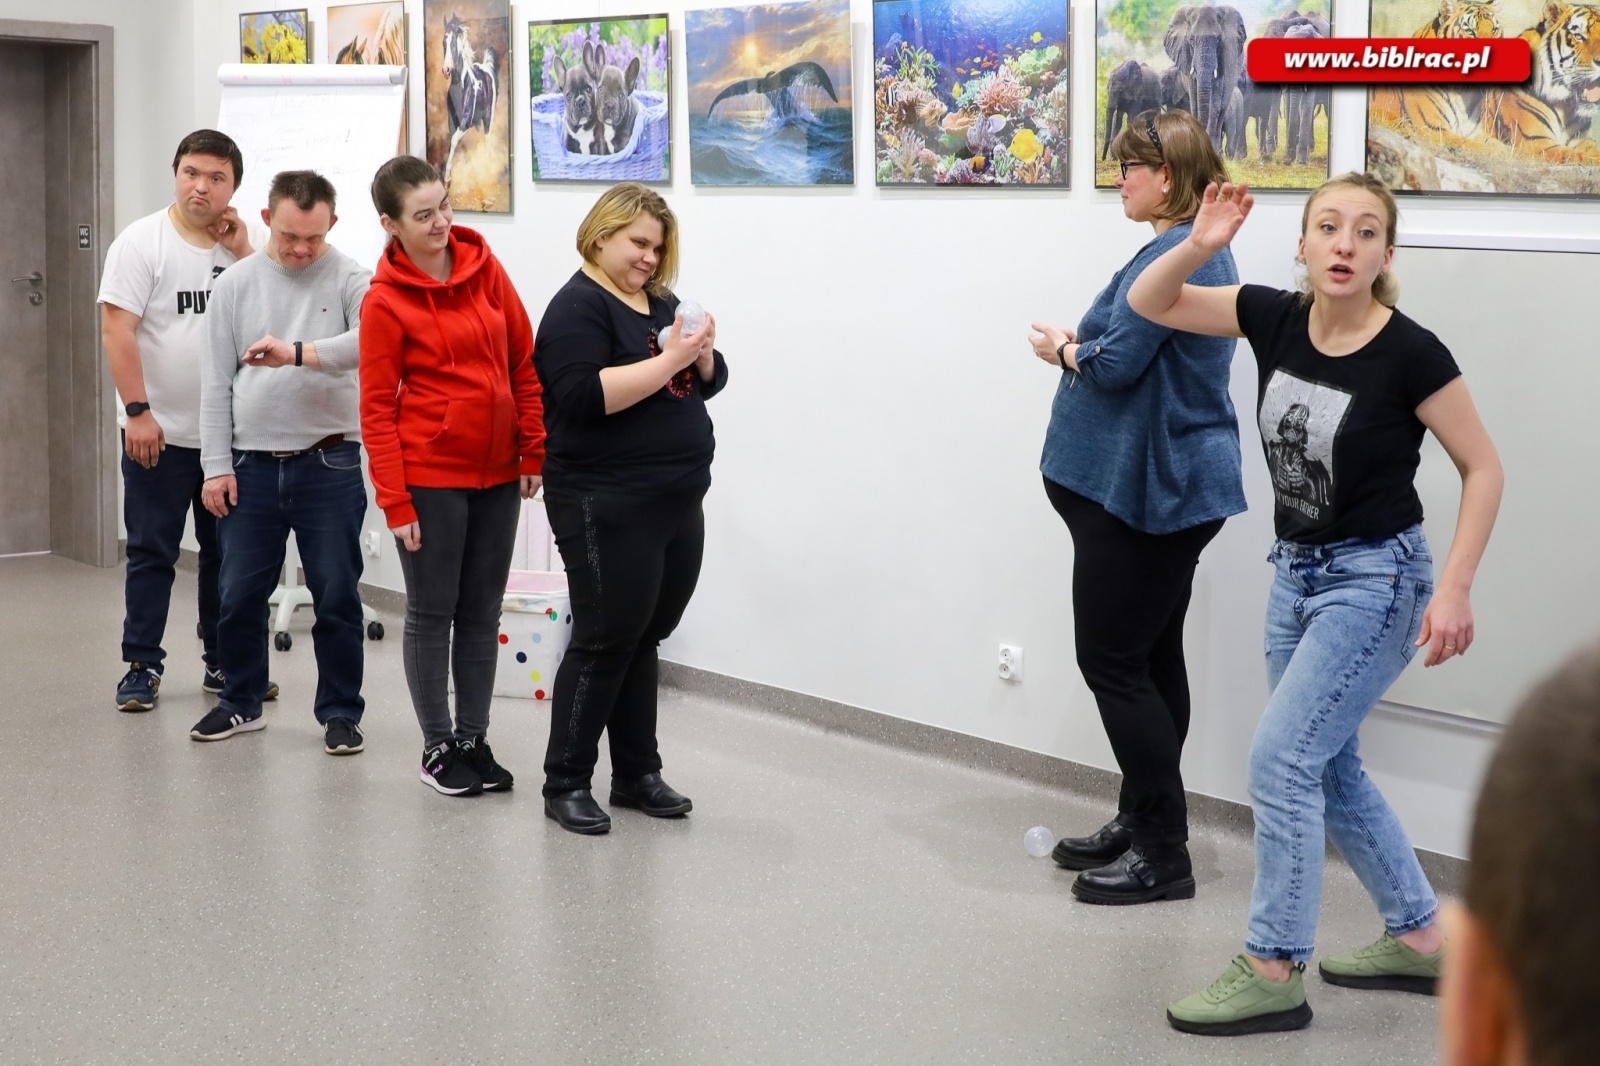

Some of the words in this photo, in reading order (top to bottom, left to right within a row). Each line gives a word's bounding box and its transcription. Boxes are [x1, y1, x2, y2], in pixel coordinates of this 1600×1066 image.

[80, 228, 88, 236] WC
[177, 290, 212, 314] PU
[1281, 493, 1299, 509] YOUR
[1299, 498, 1320, 520] FATHER
